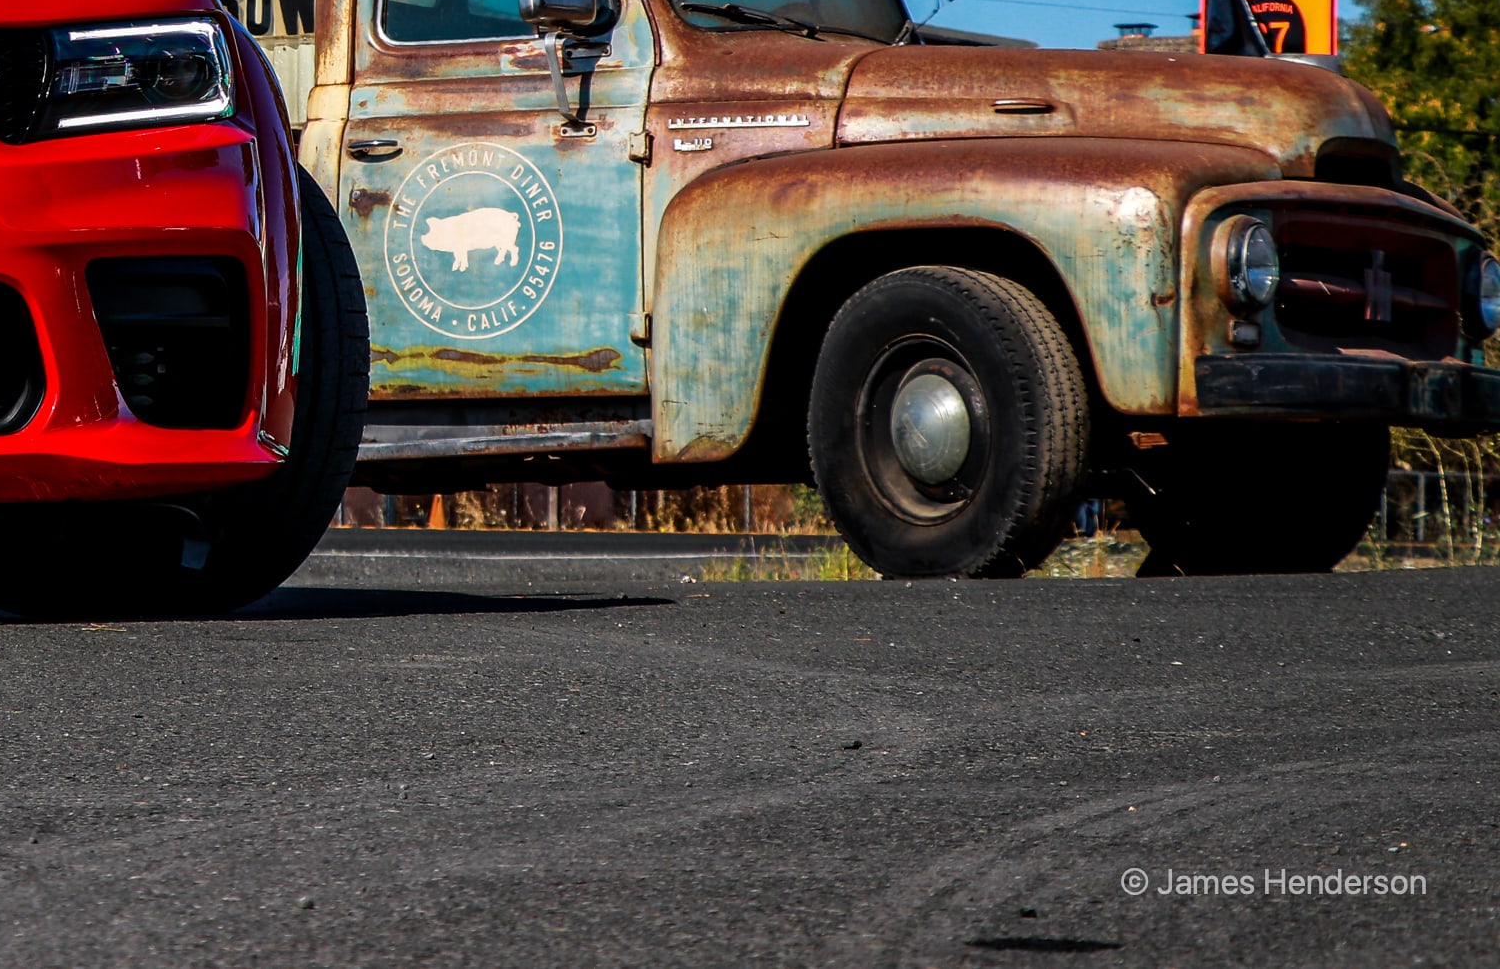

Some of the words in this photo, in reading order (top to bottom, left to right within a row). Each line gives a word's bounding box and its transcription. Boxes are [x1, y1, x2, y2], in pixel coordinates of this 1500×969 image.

[1251, 2, 1293, 14] ALIFORNIA
[1259, 22, 1290, 54] 7
[668, 115, 809, 129] INTERNATIONAL
[393, 194, 416, 229] THE
[416, 150, 506, 188] FREMONT
[510, 164, 553, 222] DINER
[393, 253, 443, 322] SONOMA
[467, 300, 526, 331] CALIF.
[522, 241, 555, 299] 95476
